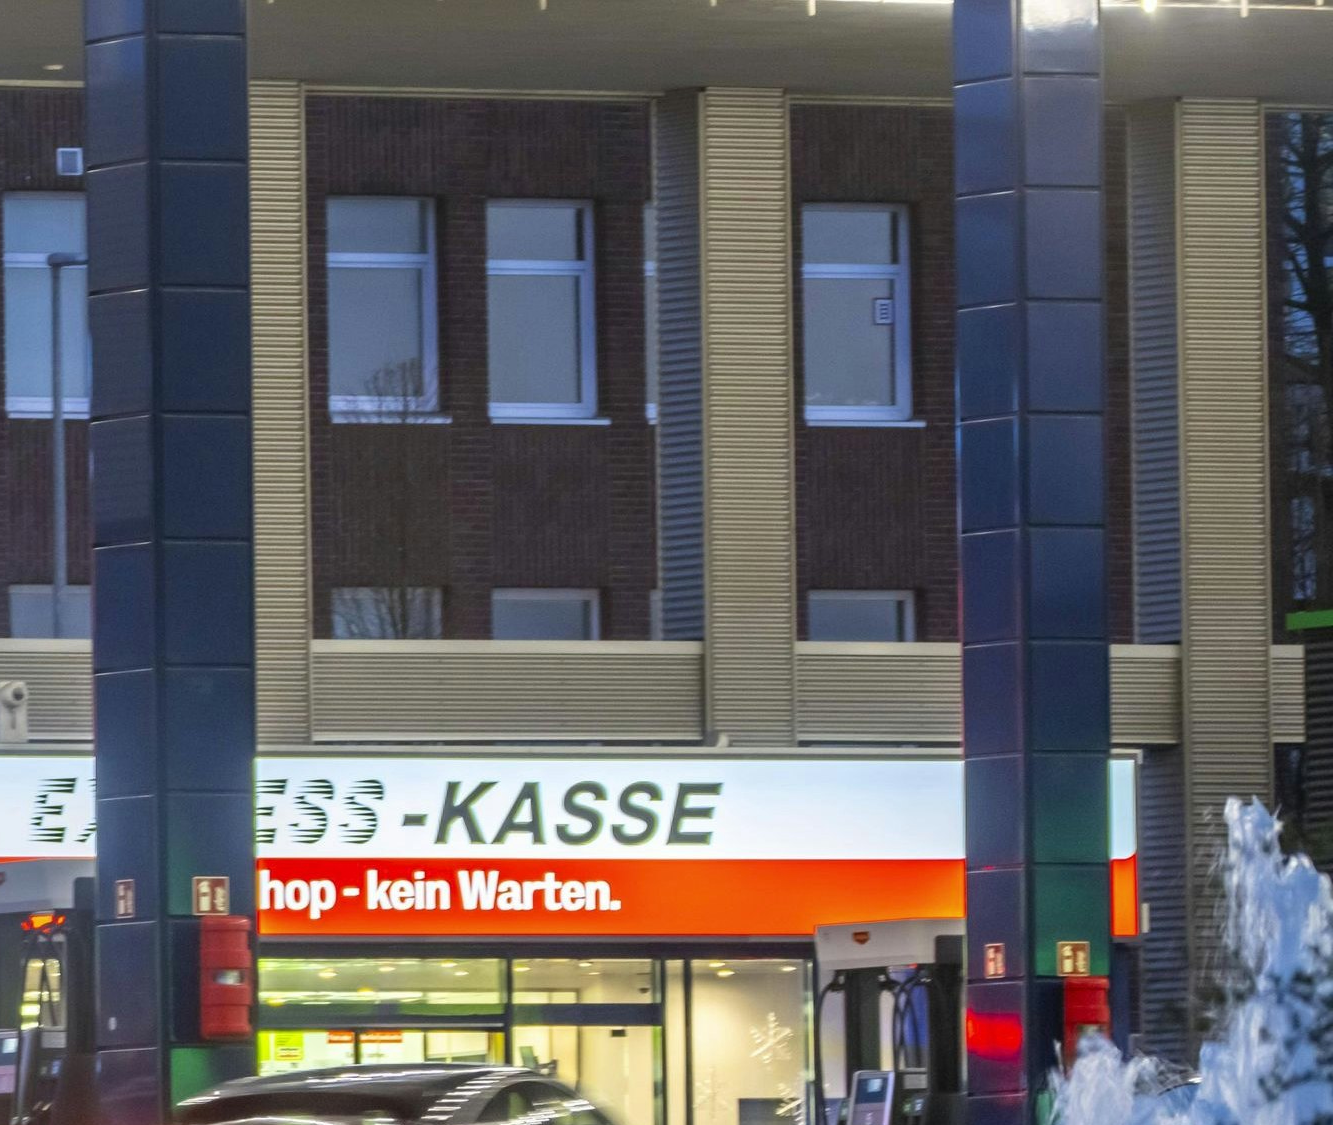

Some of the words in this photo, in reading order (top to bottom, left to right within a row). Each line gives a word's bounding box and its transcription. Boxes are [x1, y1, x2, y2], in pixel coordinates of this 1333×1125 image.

[257, 868, 337, 920] hop
[366, 868, 452, 911] kein
[456, 868, 622, 912] Warten.
